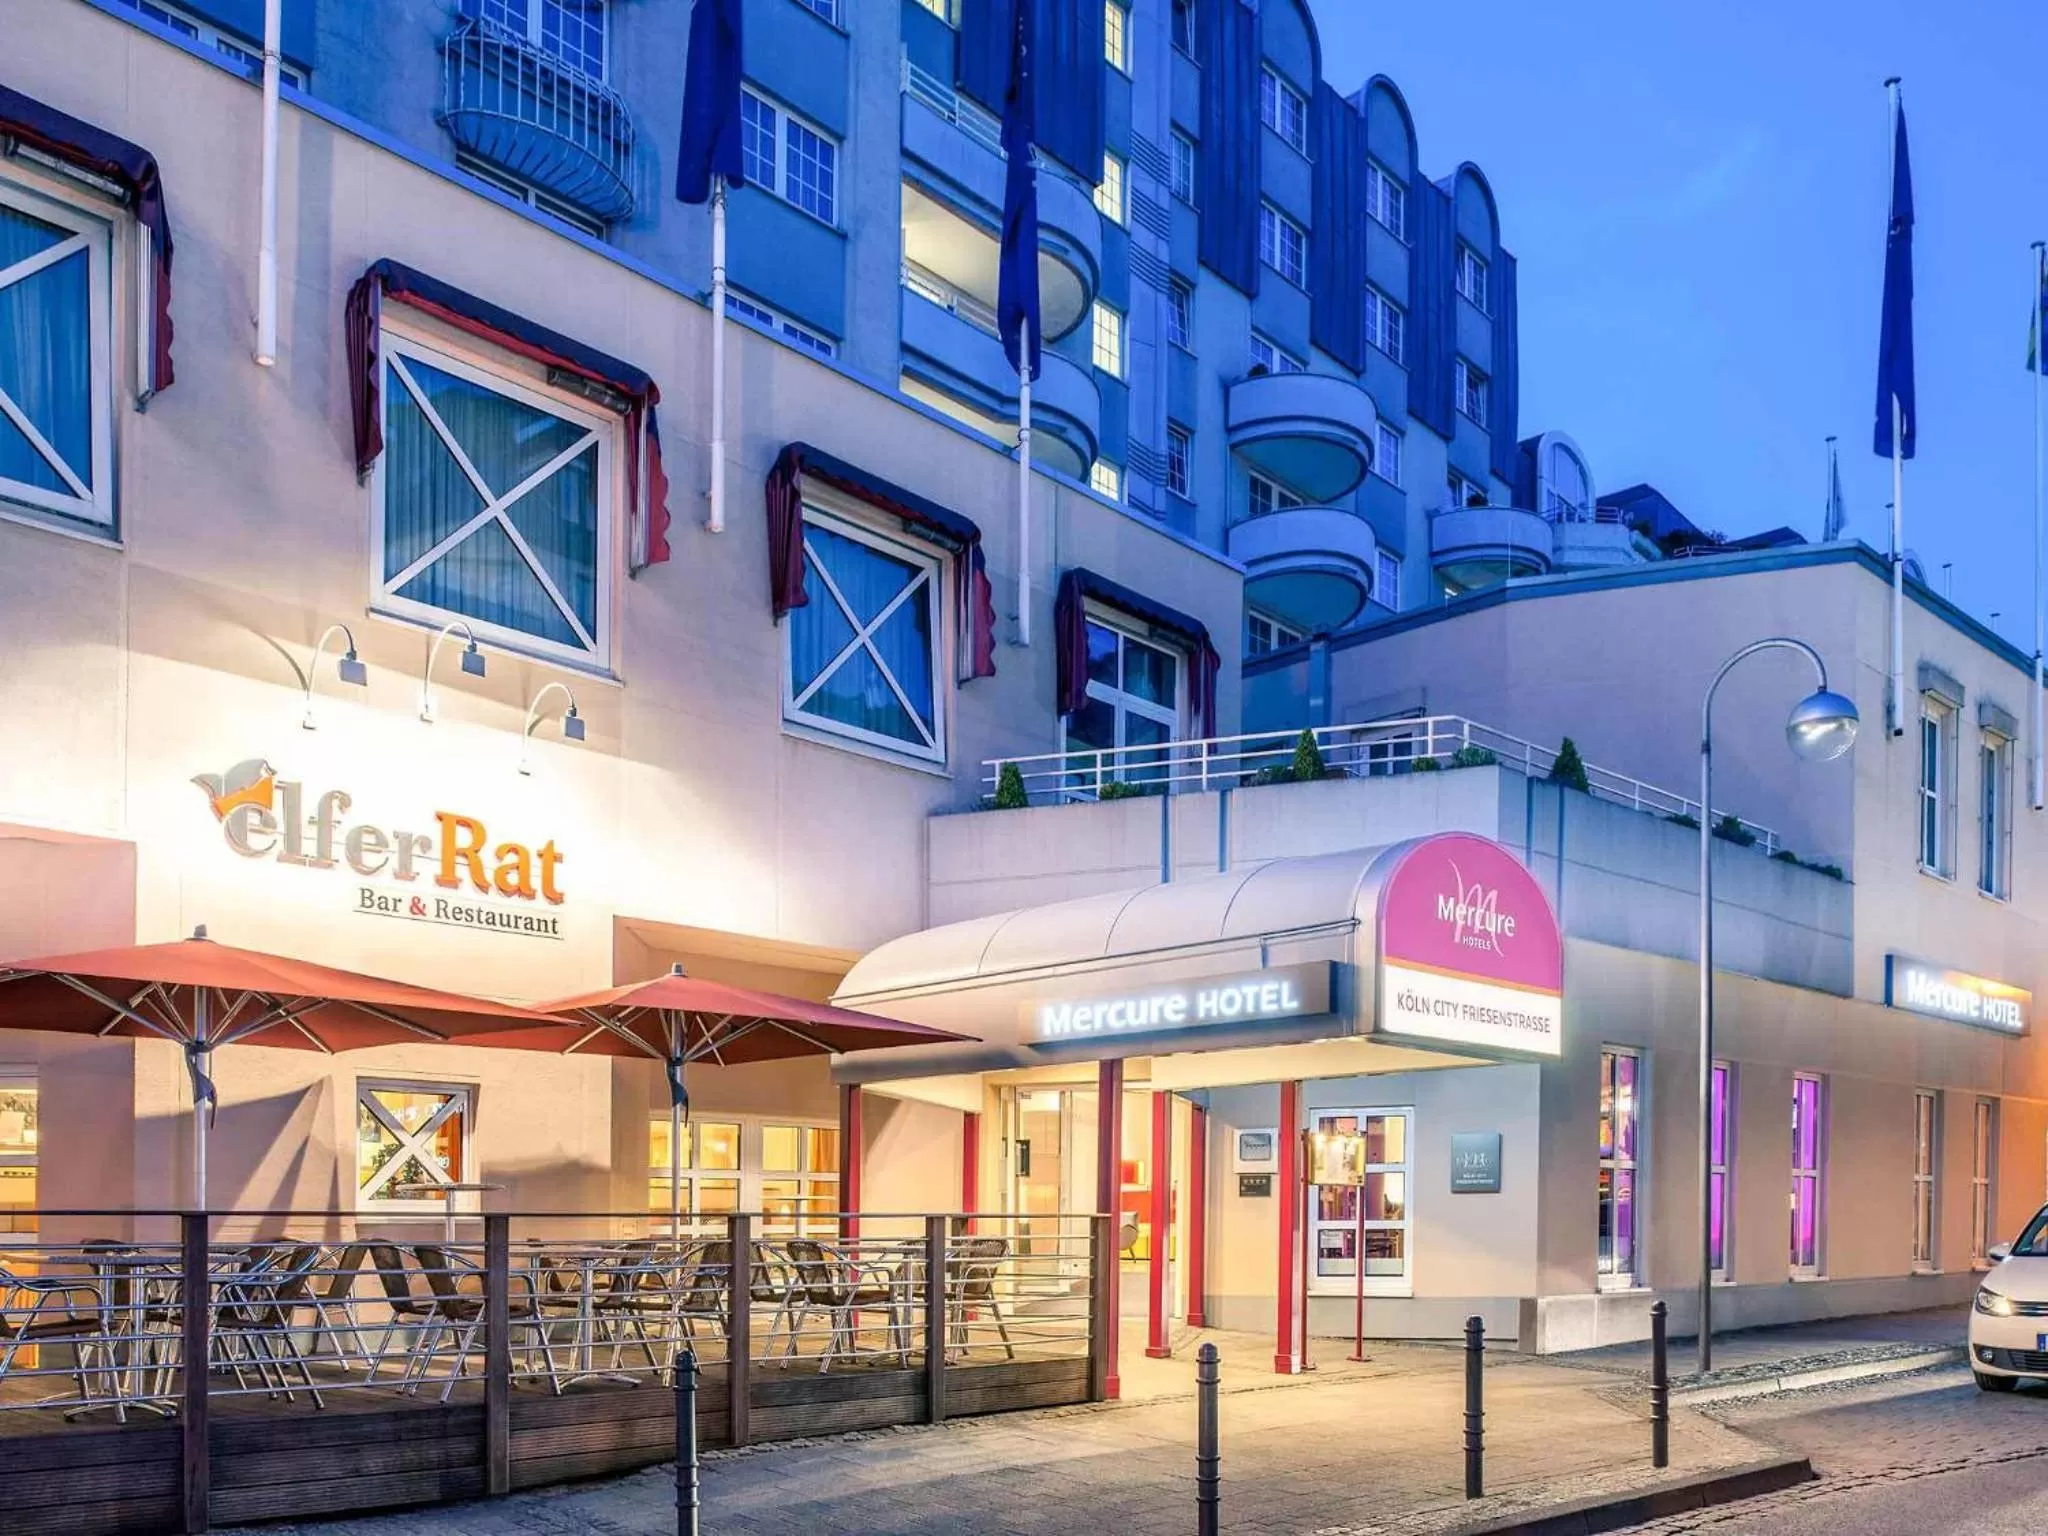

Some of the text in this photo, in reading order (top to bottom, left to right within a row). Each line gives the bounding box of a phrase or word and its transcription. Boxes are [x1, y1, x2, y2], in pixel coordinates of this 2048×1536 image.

[360, 887, 559, 935] Bar & Restaurant
[1438, 893, 1515, 937] Mercure
[1463, 936, 1492, 951] HOTELS
[1041, 980, 1299, 1036] Mercure HOTEL
[1397, 988, 1551, 1033] KÖLN CITY FRIESENSTRASSE
[1906, 969, 2024, 1028] Mercure HOTEL
